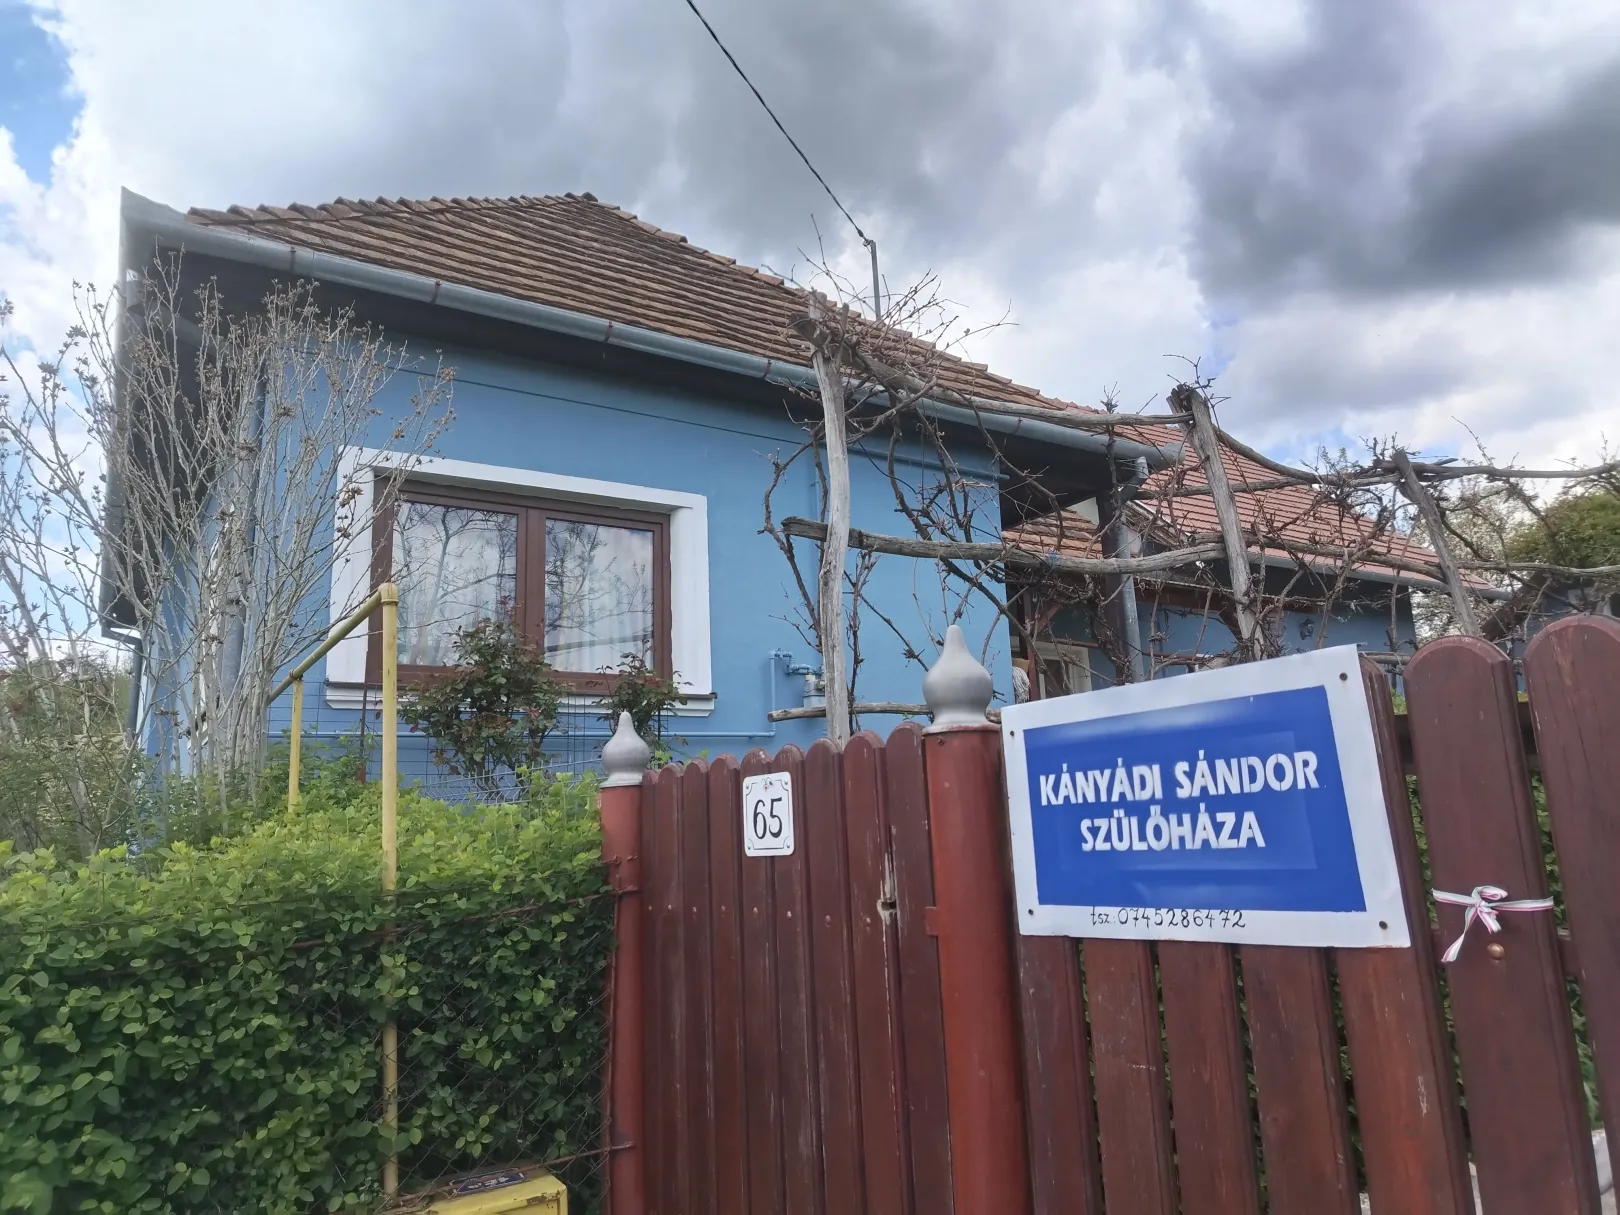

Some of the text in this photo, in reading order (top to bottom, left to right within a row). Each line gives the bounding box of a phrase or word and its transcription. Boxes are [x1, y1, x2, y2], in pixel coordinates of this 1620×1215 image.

[1039, 749, 1320, 806] KÁNYÁDI SÁNDOR
[752, 797, 783, 840] 65
[1080, 802, 1266, 852] SZÜLŐHÁZA
